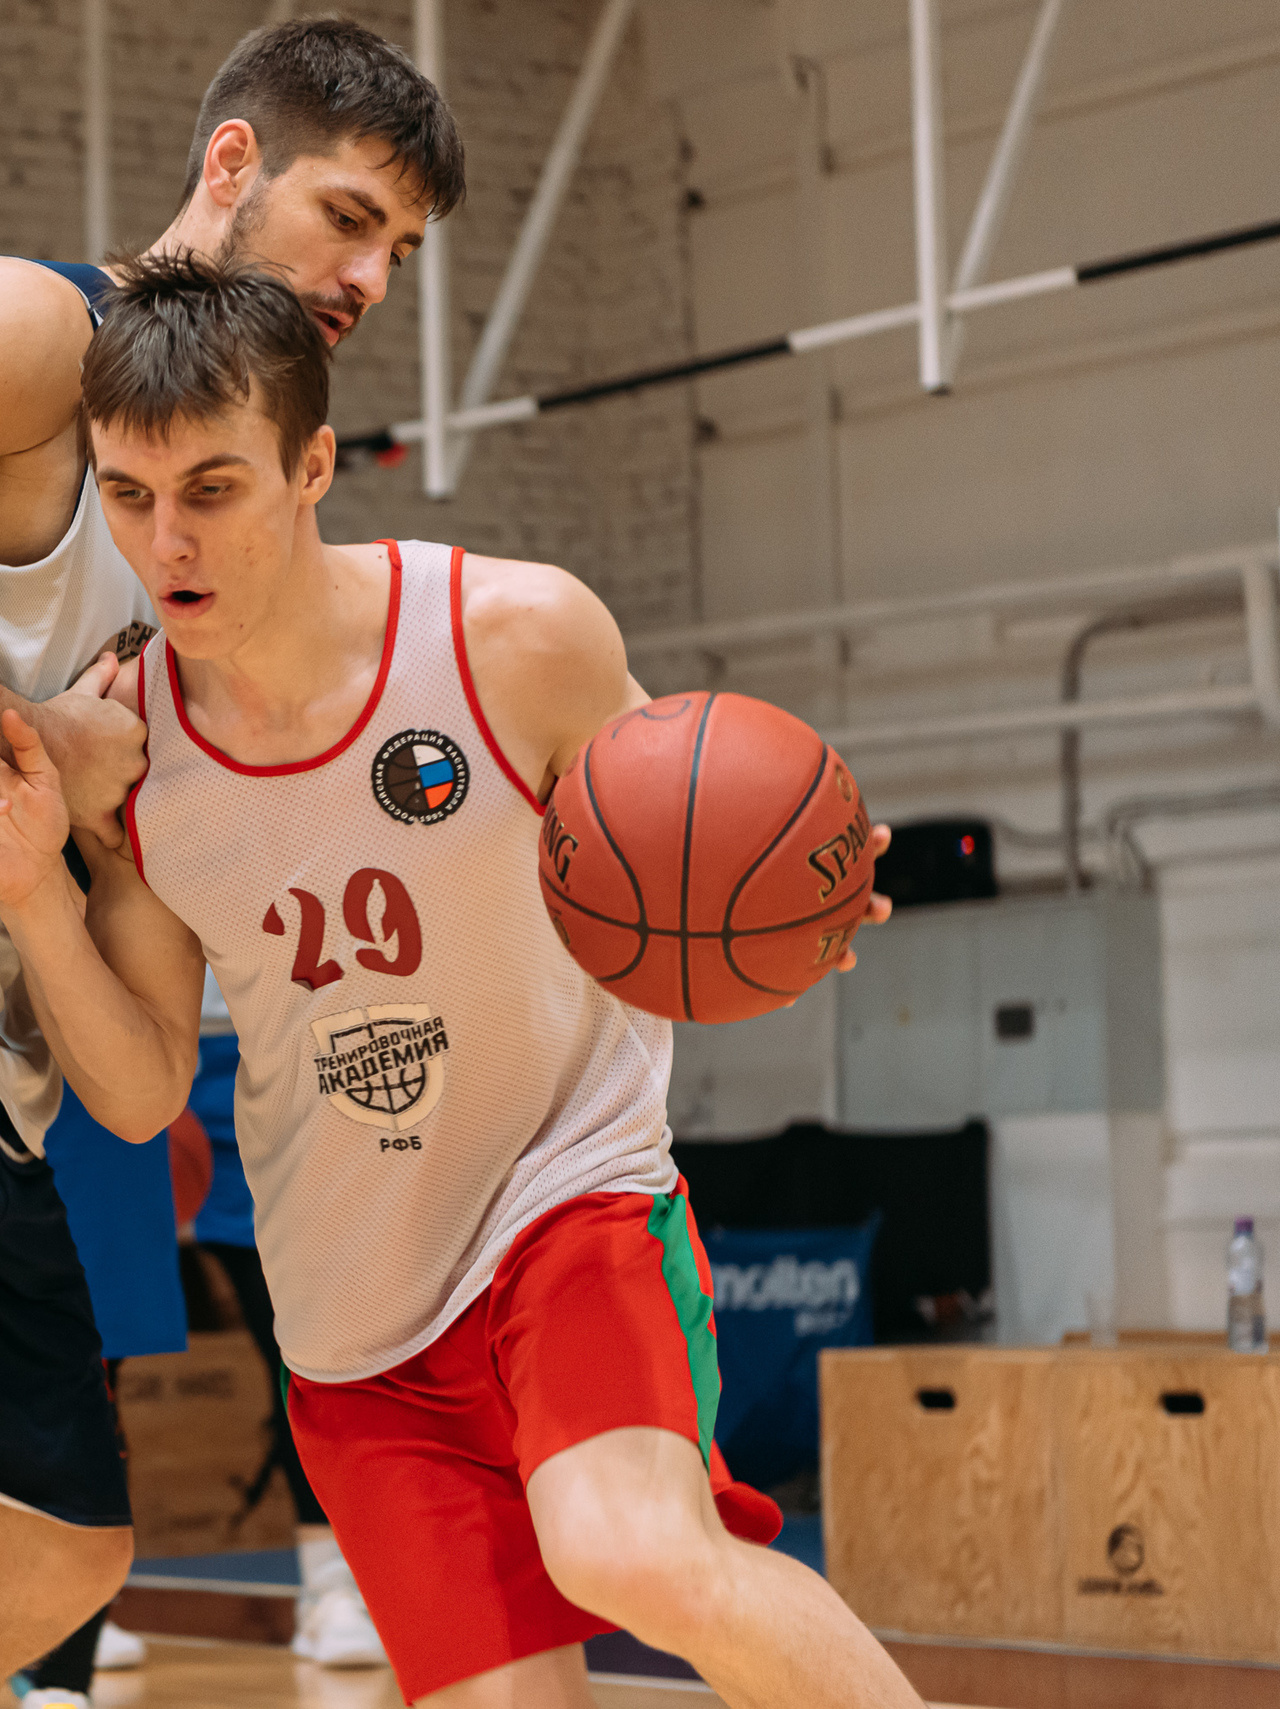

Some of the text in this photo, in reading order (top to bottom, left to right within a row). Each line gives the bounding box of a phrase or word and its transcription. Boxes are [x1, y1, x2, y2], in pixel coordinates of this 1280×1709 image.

[262, 867, 422, 992] 29
[314, 1016, 444, 1072] ТРЕНИРОВОЧНАЯ
[319, 1030, 449, 1094] АКАДЕМИЯ
[380, 1136, 422, 1152] РФБ
